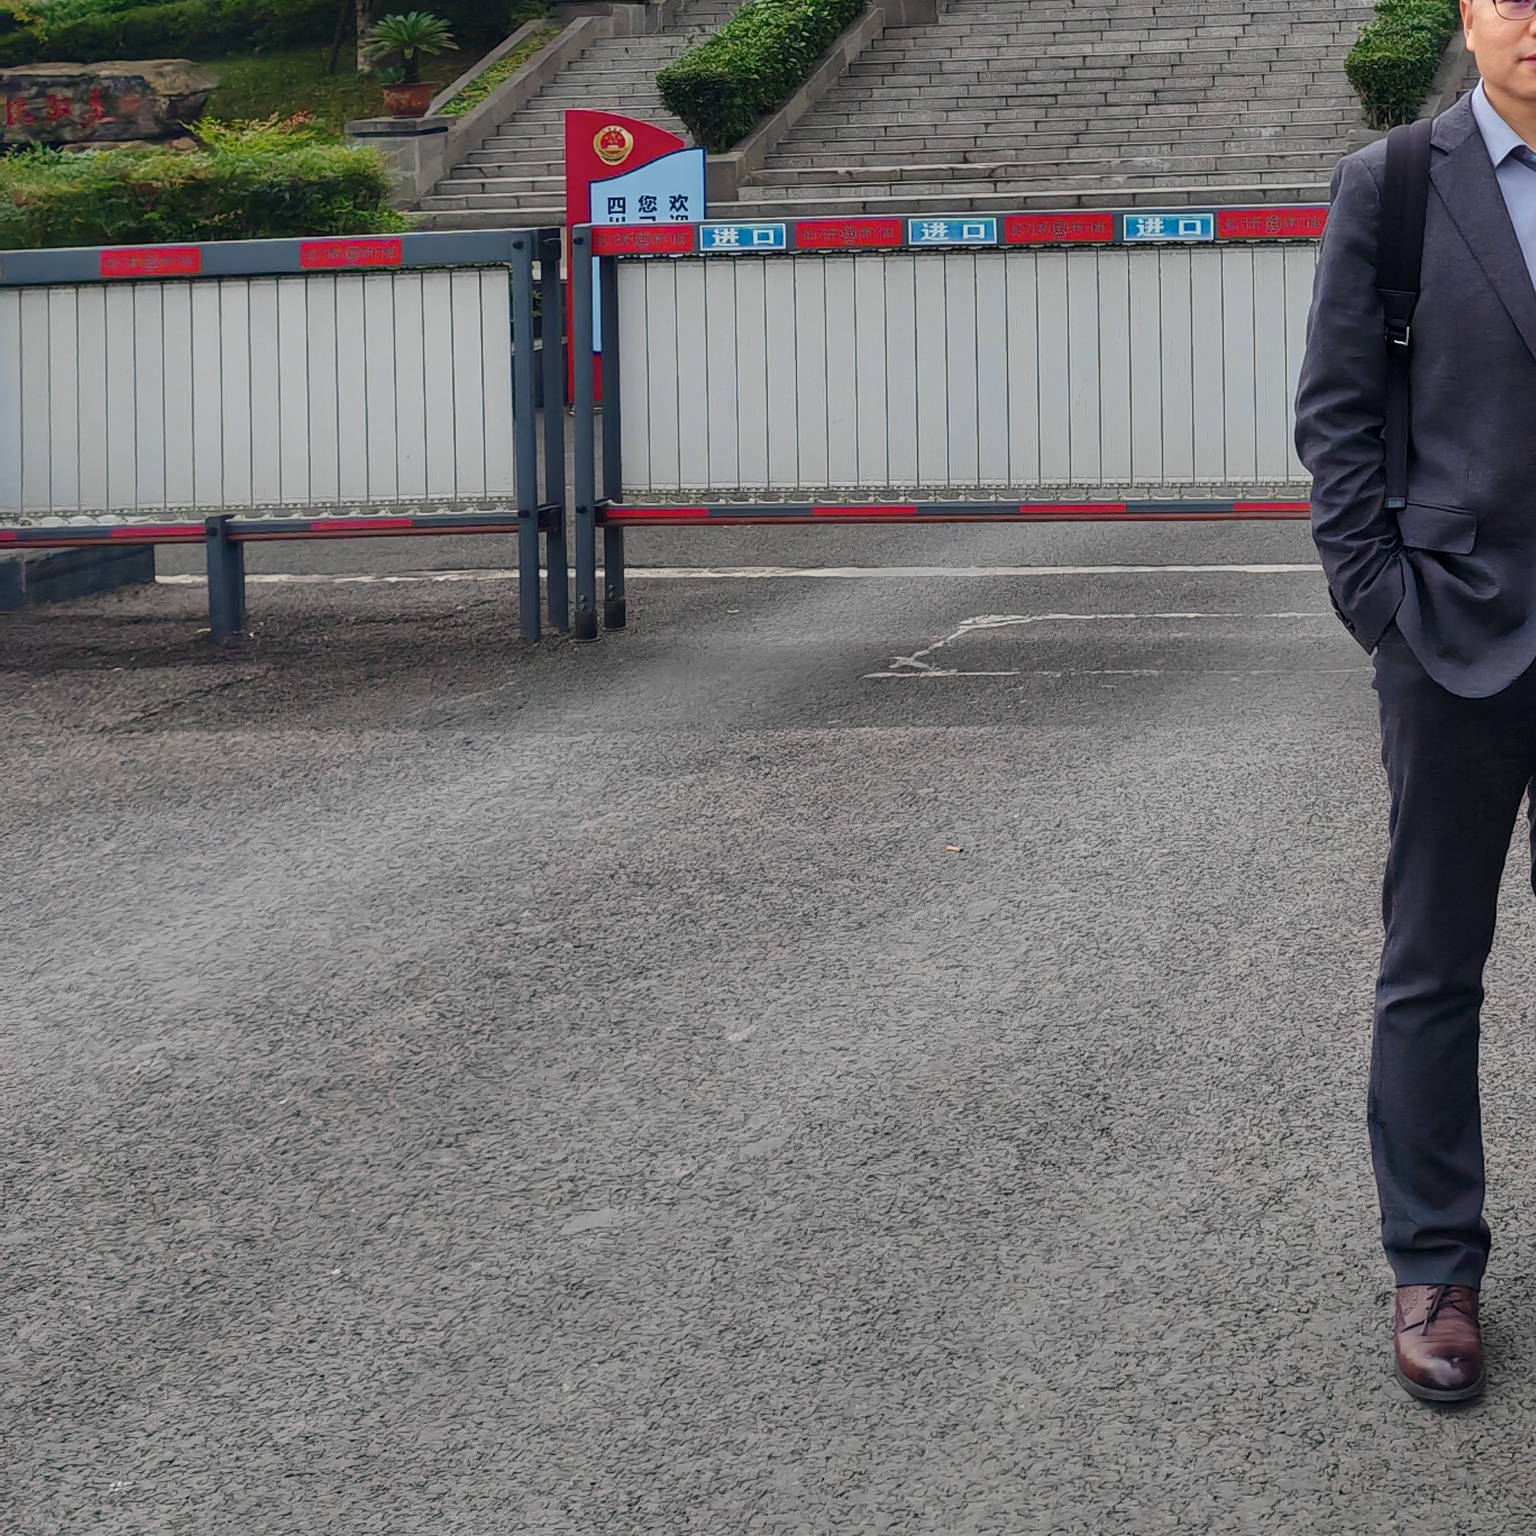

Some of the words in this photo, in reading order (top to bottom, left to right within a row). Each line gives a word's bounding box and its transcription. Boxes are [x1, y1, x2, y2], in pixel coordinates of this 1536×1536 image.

[711, 227, 776, 247] 进口
[920, 221, 985, 241] 进口
[1136, 217, 1201, 237] 进口
